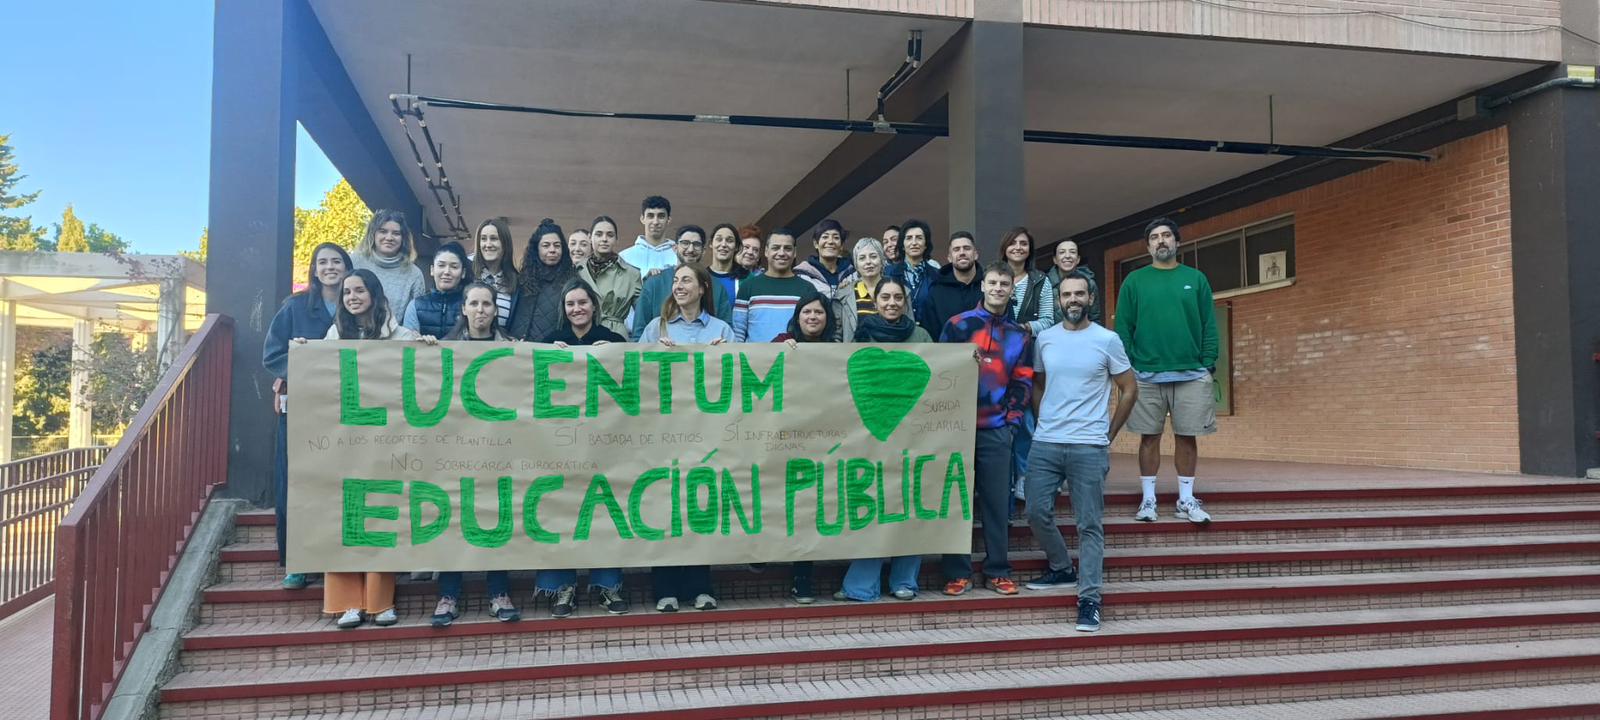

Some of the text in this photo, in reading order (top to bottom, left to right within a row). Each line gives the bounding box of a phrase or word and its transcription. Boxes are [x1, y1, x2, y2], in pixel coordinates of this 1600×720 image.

[339, 347, 784, 427] LUCENTUM
[922, 399, 960, 414] SUBIDA
[744, 429, 848, 441] INFRAESTRUCTURAS
[911, 419, 967, 437] SALARIAL
[308, 434, 512, 451] NO A LOS RECORTES DE PLANTILLA
[588, 432, 633, 446] BAJADA
[640, 432, 655, 445] DE
[661, 433, 703, 444] RATIOS
[765, 442, 806, 452] DIGNAS
[435, 460, 513, 472] SOBRECARGA
[342, 443, 971, 548] EDUCACIÓN PÚBLICA
